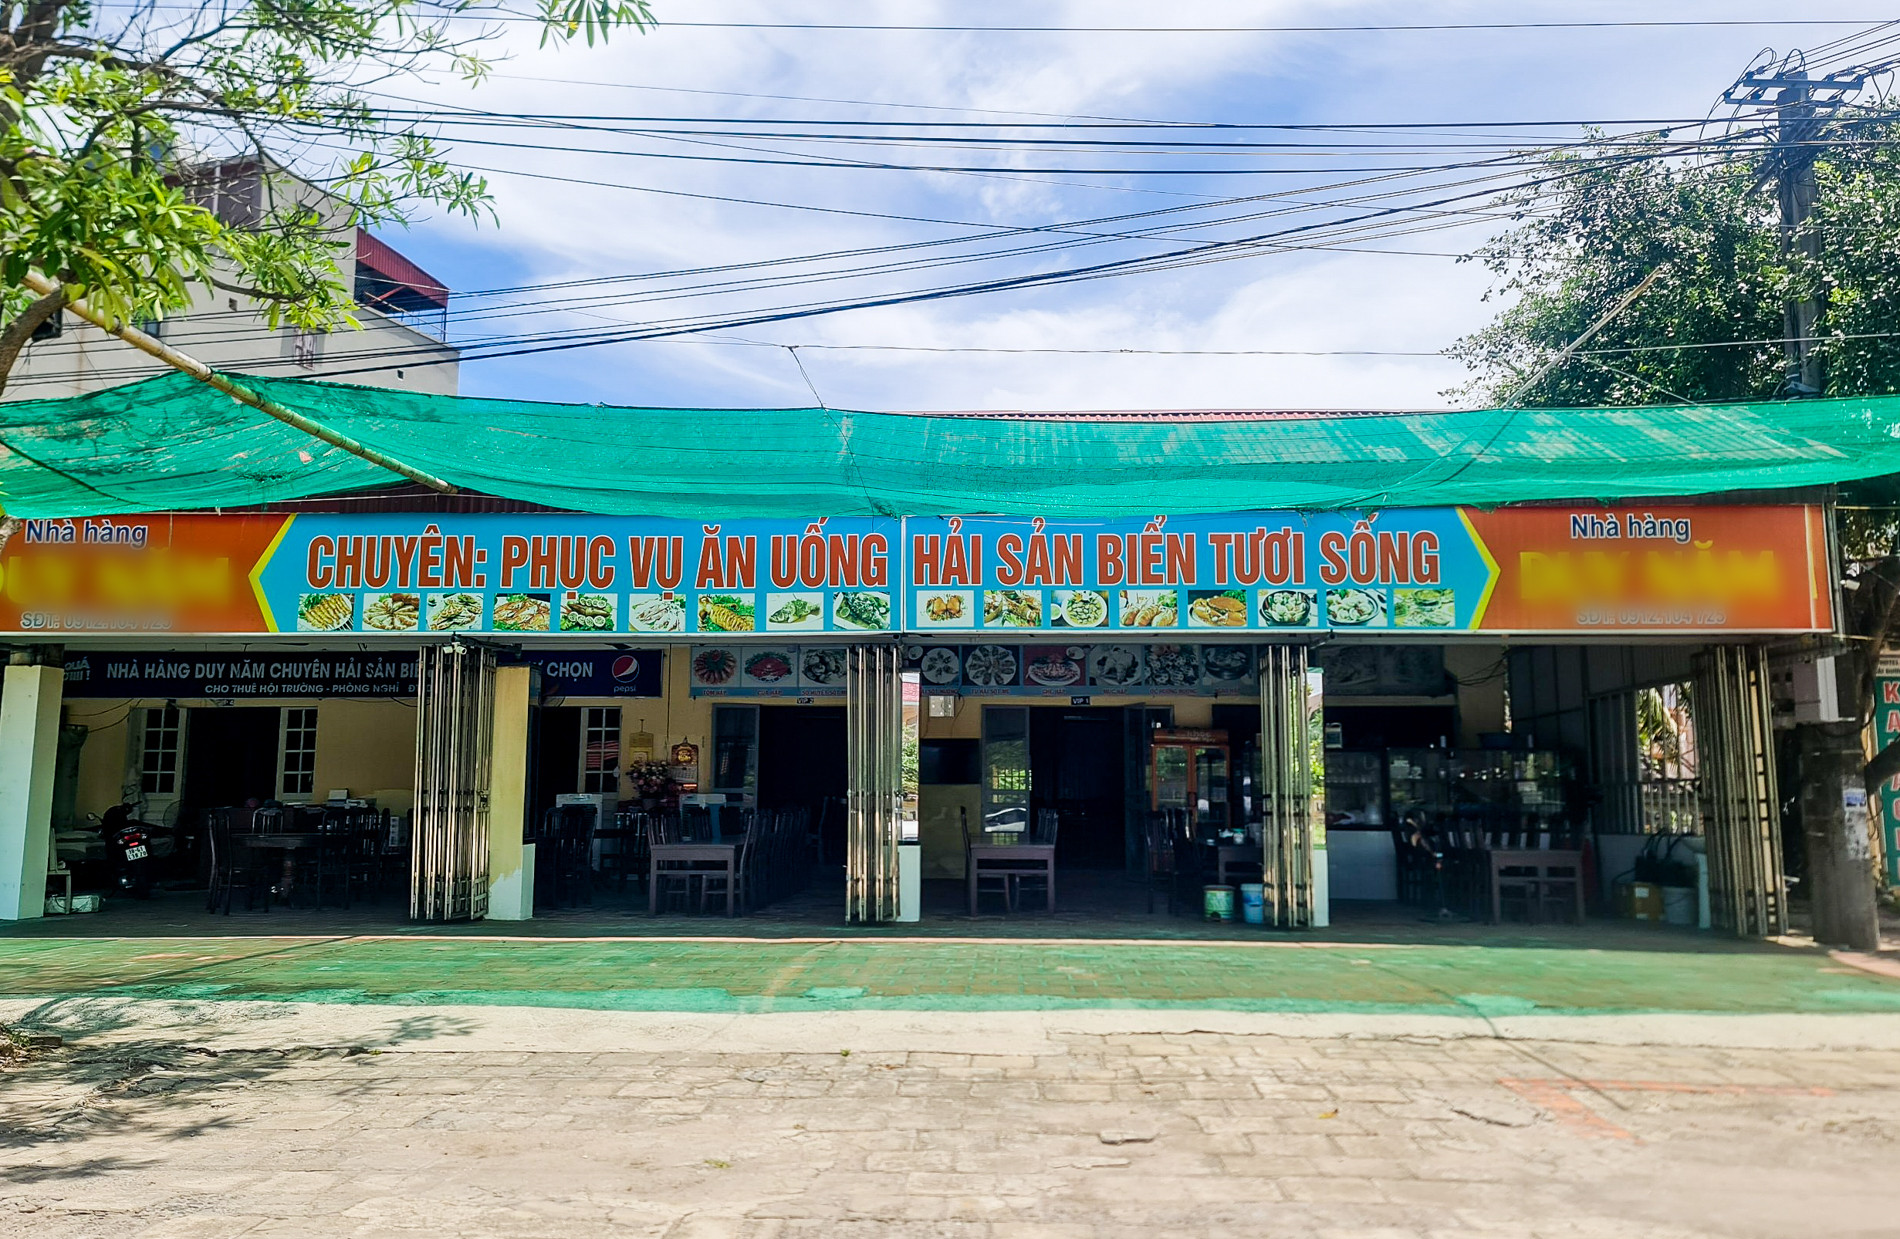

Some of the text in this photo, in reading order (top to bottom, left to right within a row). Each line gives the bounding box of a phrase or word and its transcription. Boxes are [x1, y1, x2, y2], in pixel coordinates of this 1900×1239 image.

[25, 519, 148, 549] Nhà hàng
[1570, 513, 1691, 544] Nhà hàng
[306, 524, 486, 590] CHUYÊN:
[500, 534, 616, 600] PHỤC
[629, 535, 685, 600] VỤ
[694, 524, 757, 589] ĂN
[770, 517, 889, 588] UỐNG
[913, 517, 982, 587] HẢI
[996, 517, 1083, 587] SẢN
[1097, 514, 1197, 587] BIỂN
[1208, 526, 1305, 586] TƯƠI
[1319, 512, 1441, 586] SỐNG
[106, 659, 139, 678] NHÀ
[144, 659, 191, 679] HÀNG
[194, 663, 226, 678] DUY
[229, 659, 265, 678] NĂM
[269, 659, 330, 679] CHUYÊN
[335, 657, 361, 678] HẢI
[365, 657, 396, 678] SẢN
[546, 661, 594, 682] CHỌN
[204, 684, 230, 693] CHO
[231, 682, 257, 693] THUÊ
[259, 682, 279, 696] HỘI
[281, 682, 324, 693] TRƯỜNG
[332, 682, 370, 693] PHÒNG
[613, 684, 637, 694] pepsi
